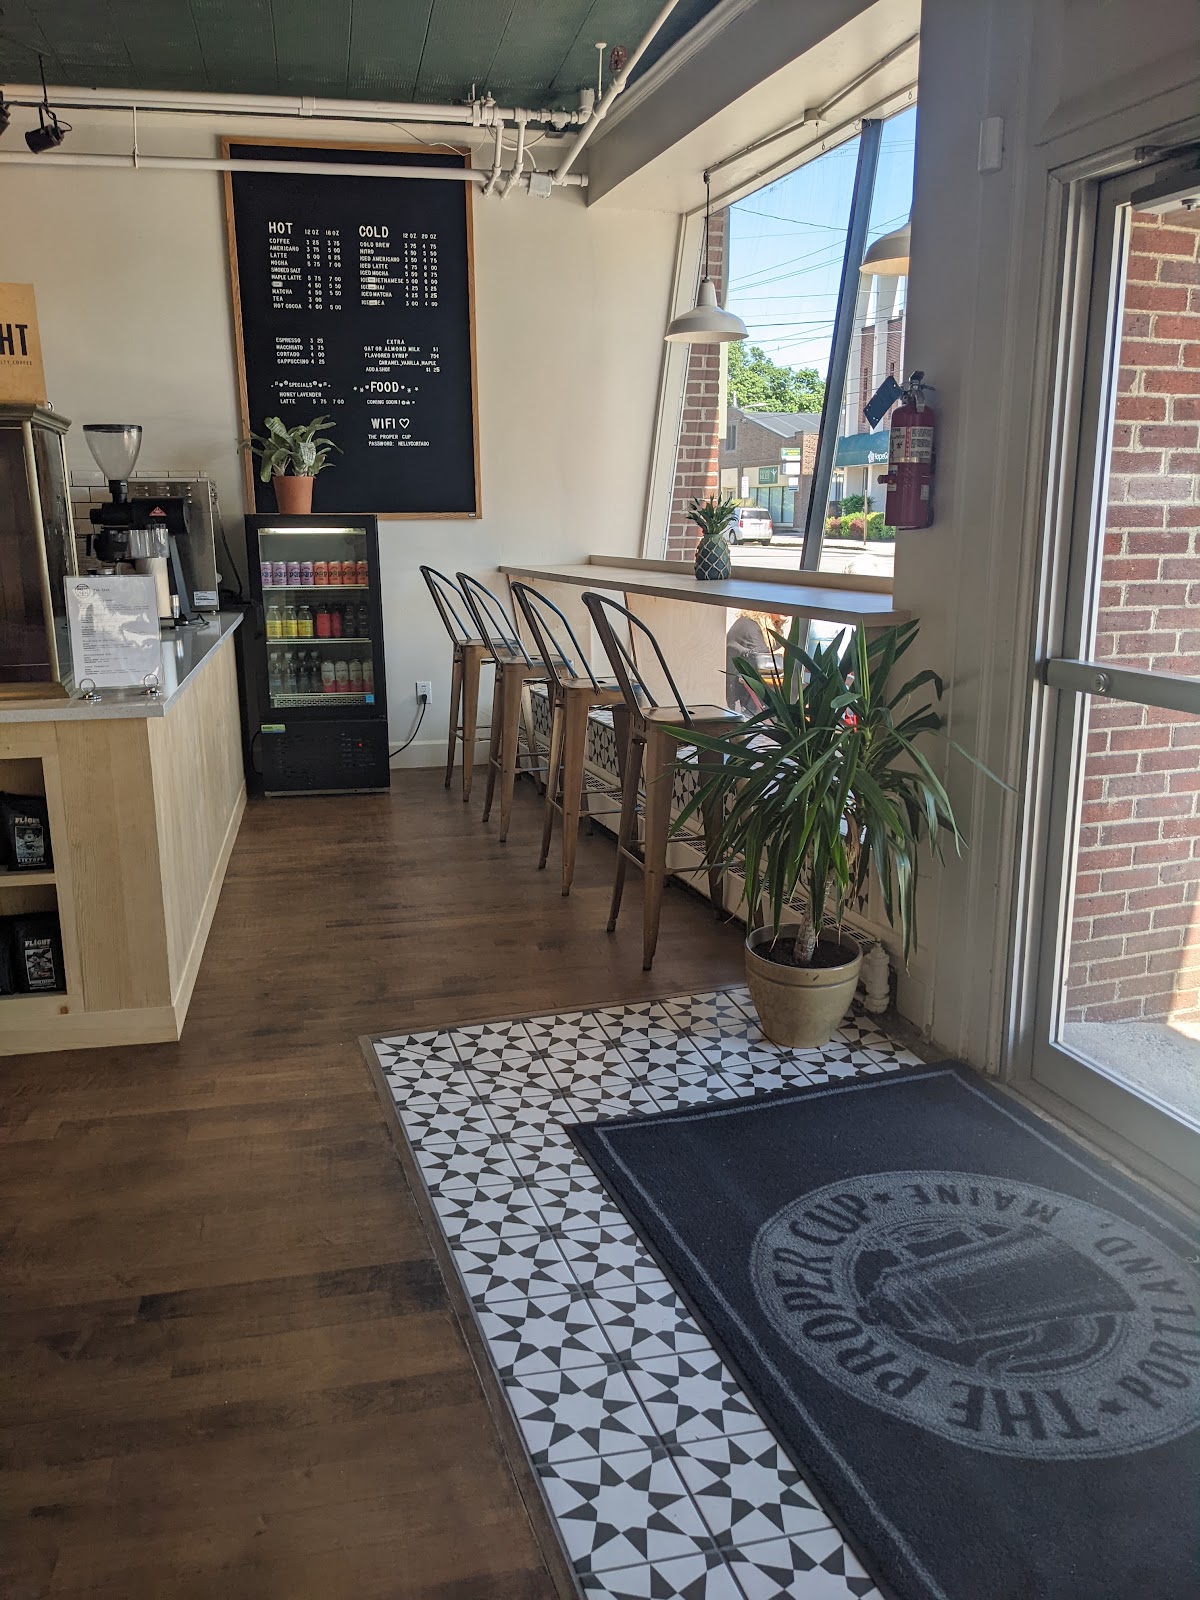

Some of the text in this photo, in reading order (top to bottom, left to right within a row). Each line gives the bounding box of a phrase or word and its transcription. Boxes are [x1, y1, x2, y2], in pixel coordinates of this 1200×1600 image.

[268, 222, 293, 234] HOT
[359, 225, 389, 238] COLD
[0, 323, 28, 356] HT
[370, 381, 399, 392] FOOD
[371, 418, 396, 429] WIFI
[904, 1183, 1060, 1224] MAINE
[774, 1193, 1099, 1440] THE PROPER CUP
